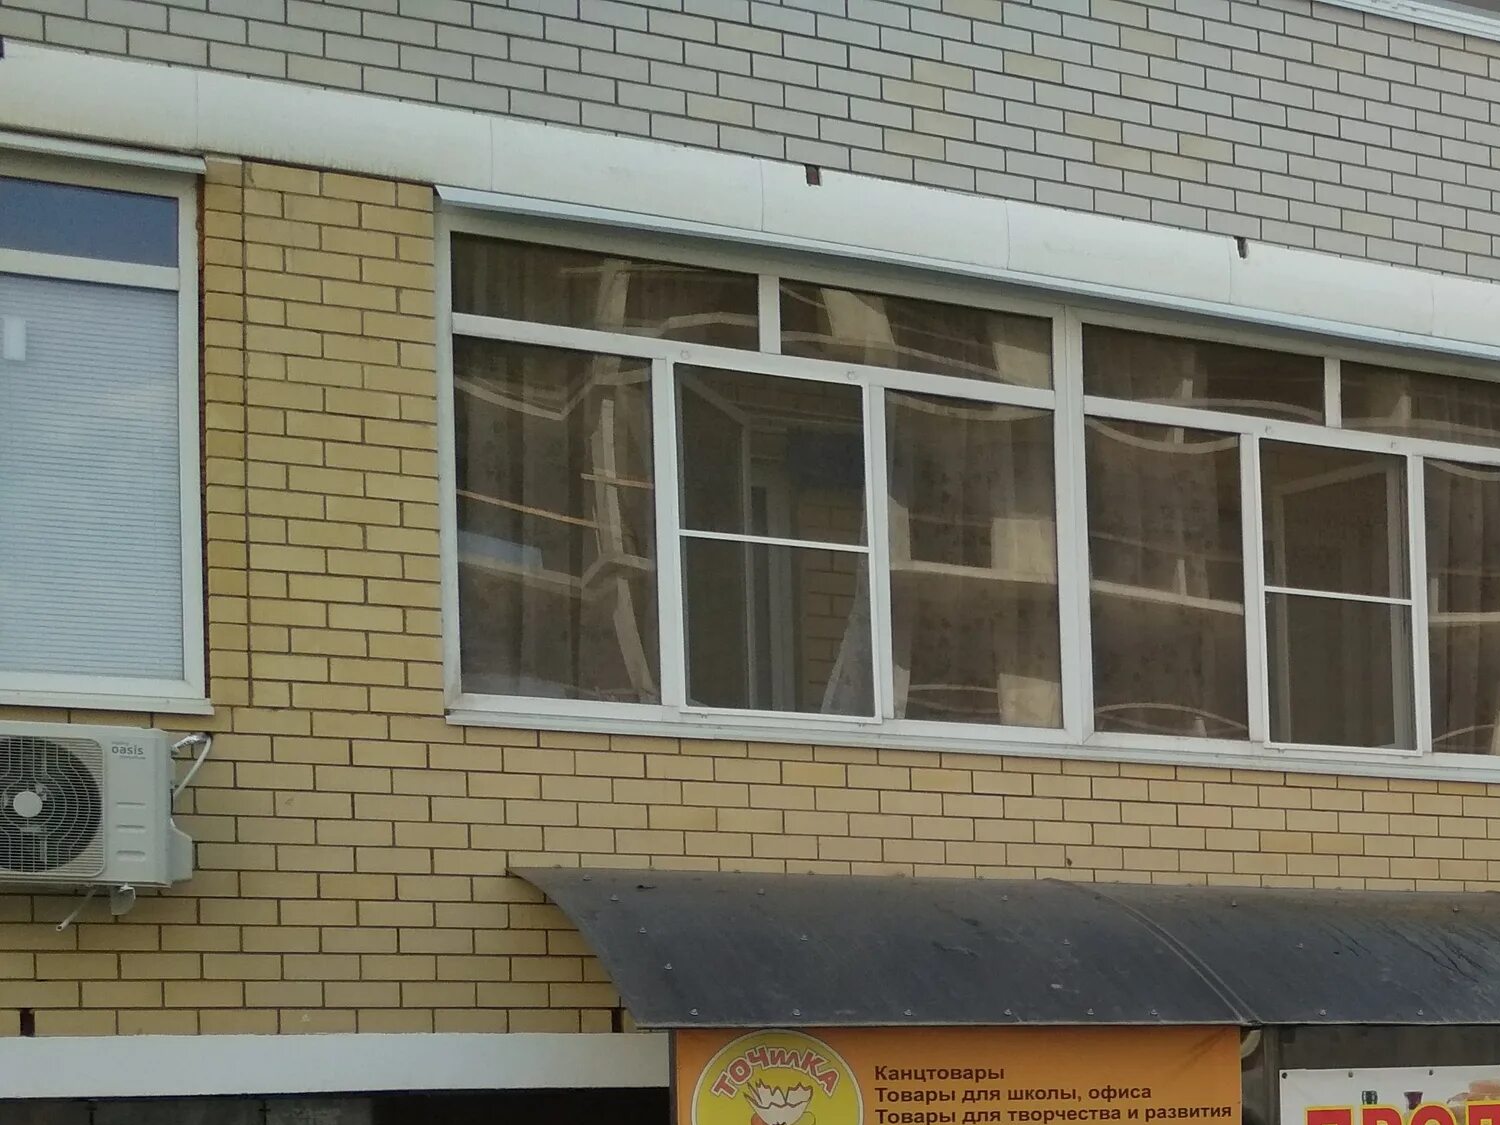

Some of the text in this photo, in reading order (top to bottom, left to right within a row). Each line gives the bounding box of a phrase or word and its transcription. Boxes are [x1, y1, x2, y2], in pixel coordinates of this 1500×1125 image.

[112, 744, 144, 756] oasis
[874, 1064, 1005, 1083] Канцтовары
[874, 1084, 1152, 1106] Товары для школы, офиса
[962, 1108, 1001, 1125] для
[1007, 1106, 1121, 1124] творчества
[1127, 1106, 1139, 1119] и
[1144, 1103, 1232, 1122] развития
